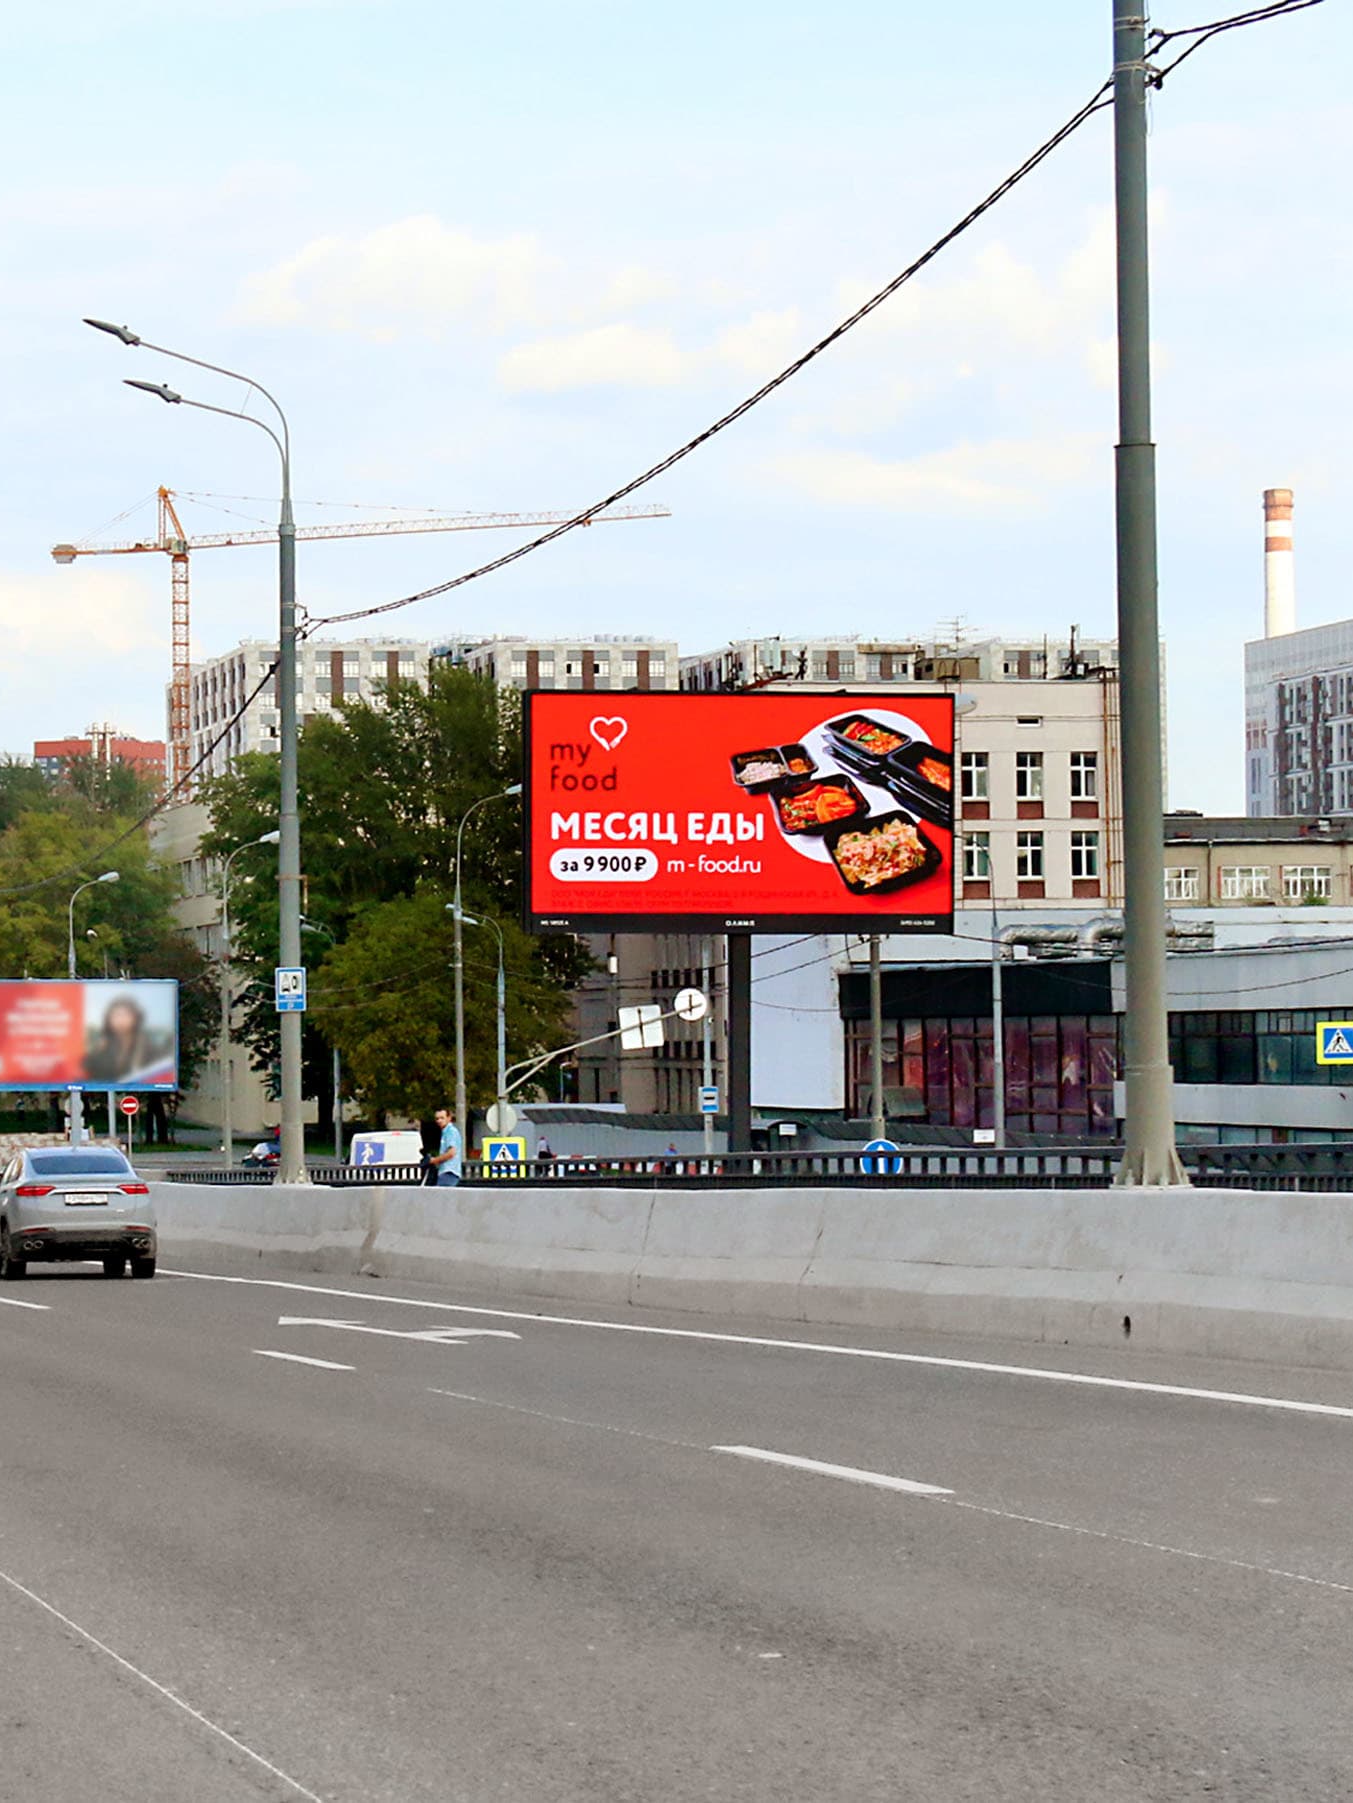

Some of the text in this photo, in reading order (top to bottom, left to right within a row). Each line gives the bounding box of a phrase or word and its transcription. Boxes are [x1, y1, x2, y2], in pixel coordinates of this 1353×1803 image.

[550, 743, 592, 767] my
[550, 765, 617, 792] food
[550, 812, 764, 845] МЕСЯЦ ЕДЫ
[560, 860, 579, 872] за
